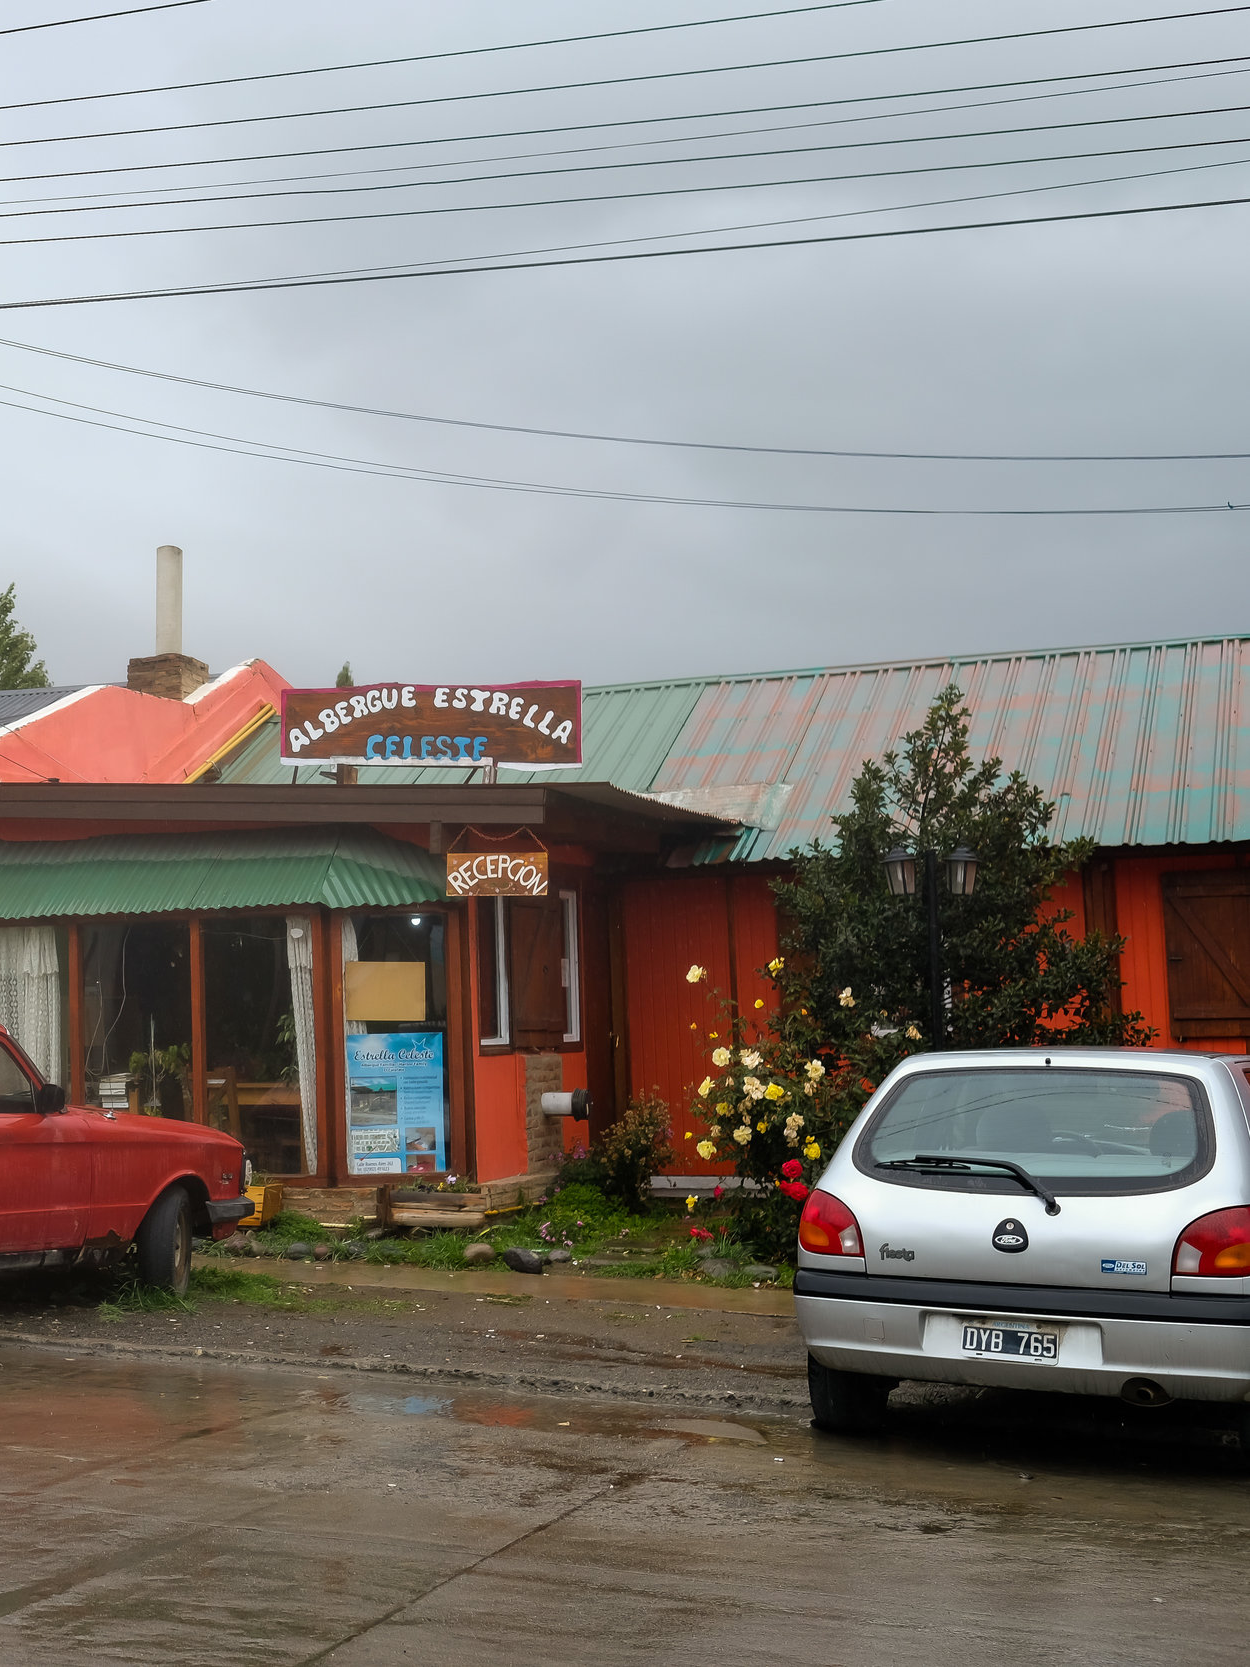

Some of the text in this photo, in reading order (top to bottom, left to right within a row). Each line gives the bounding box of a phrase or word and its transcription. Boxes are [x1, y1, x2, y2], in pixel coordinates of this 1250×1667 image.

[289, 686, 573, 753] ALBERGUE ESTRELLA
[365, 734, 489, 761] CELESTE
[447, 855, 548, 895] RECEPCION
[354, 1048, 434, 1060] Estrella Celeste
[992, 1321, 1030, 1329] ARGENTINA
[965, 1328, 1055, 1357] DYB 765
